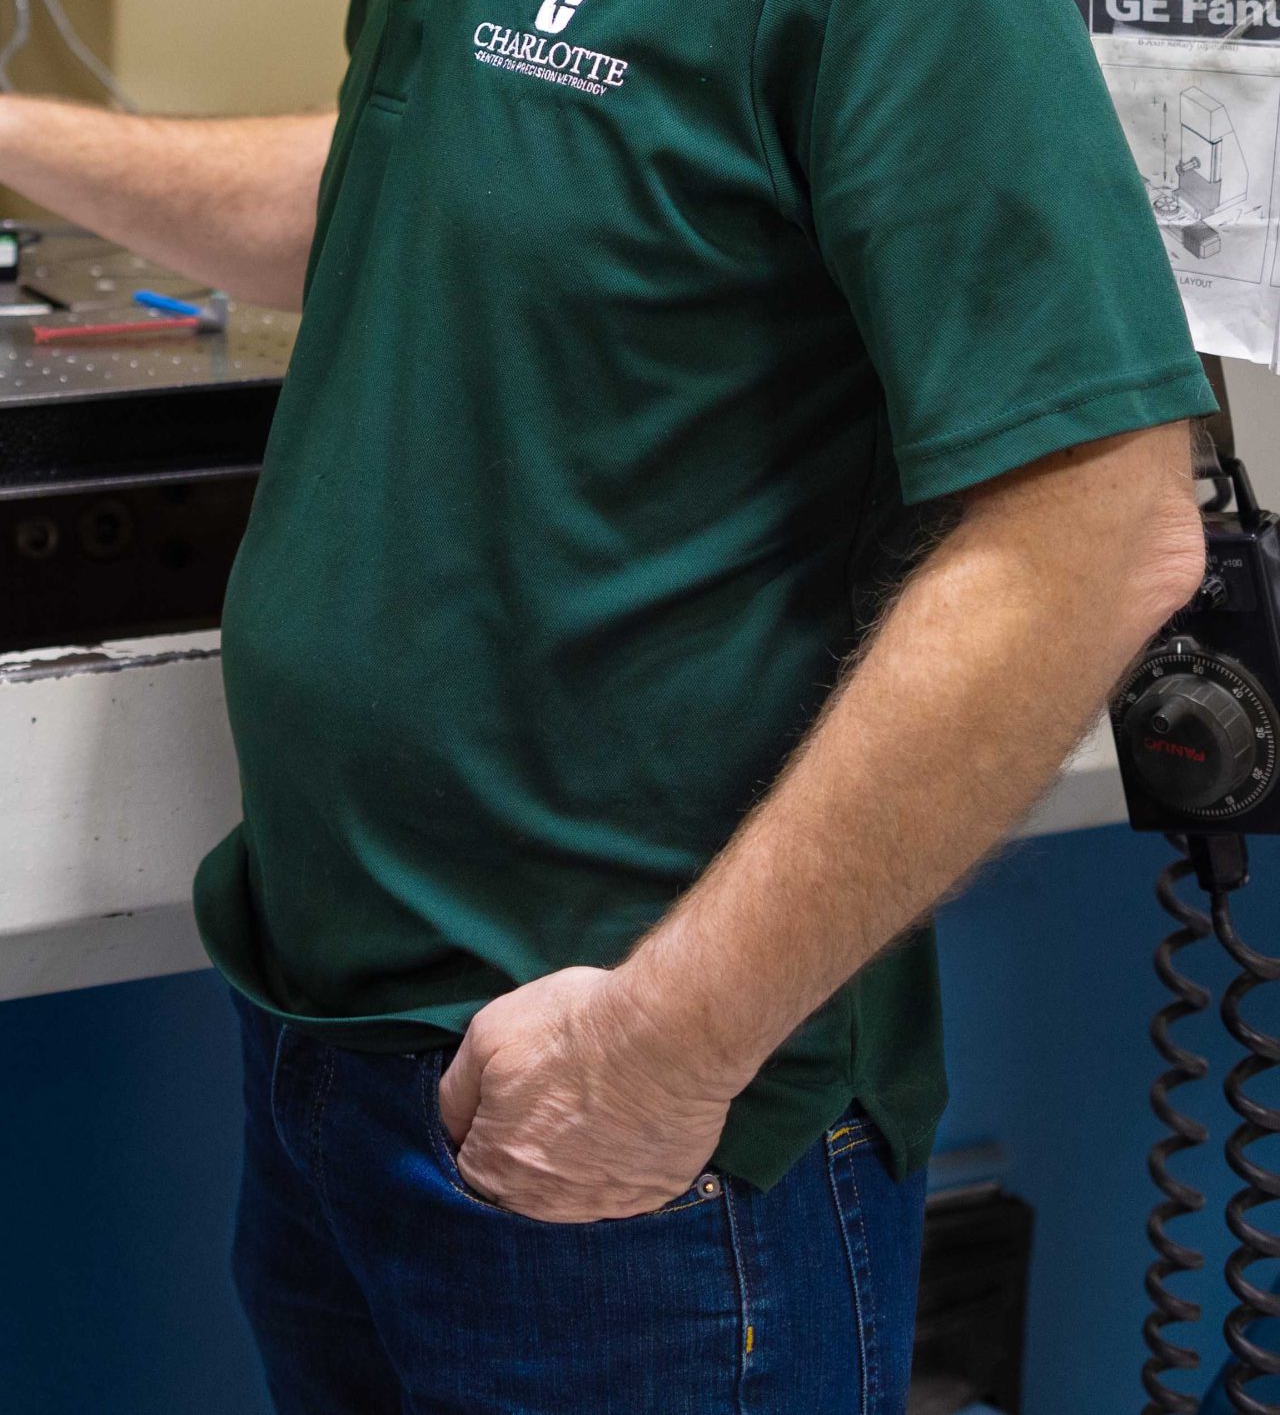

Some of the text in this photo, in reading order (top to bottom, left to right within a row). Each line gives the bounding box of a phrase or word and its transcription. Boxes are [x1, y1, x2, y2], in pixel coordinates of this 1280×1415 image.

[473, 21, 629, 87] CHARLOTTE
[474, 49, 608, 97] CENTER FOR PRECISION METROLOGY
[1179, 276, 1213, 289] LAYOUT
[1192, 665, 1205, 675] 50
[1231, 687, 1244, 699] 40
[1255, 726, 1266, 739] 30
[1143, 737, 1206, 762] FANUC
[1252, 766, 1263, 780] 20
